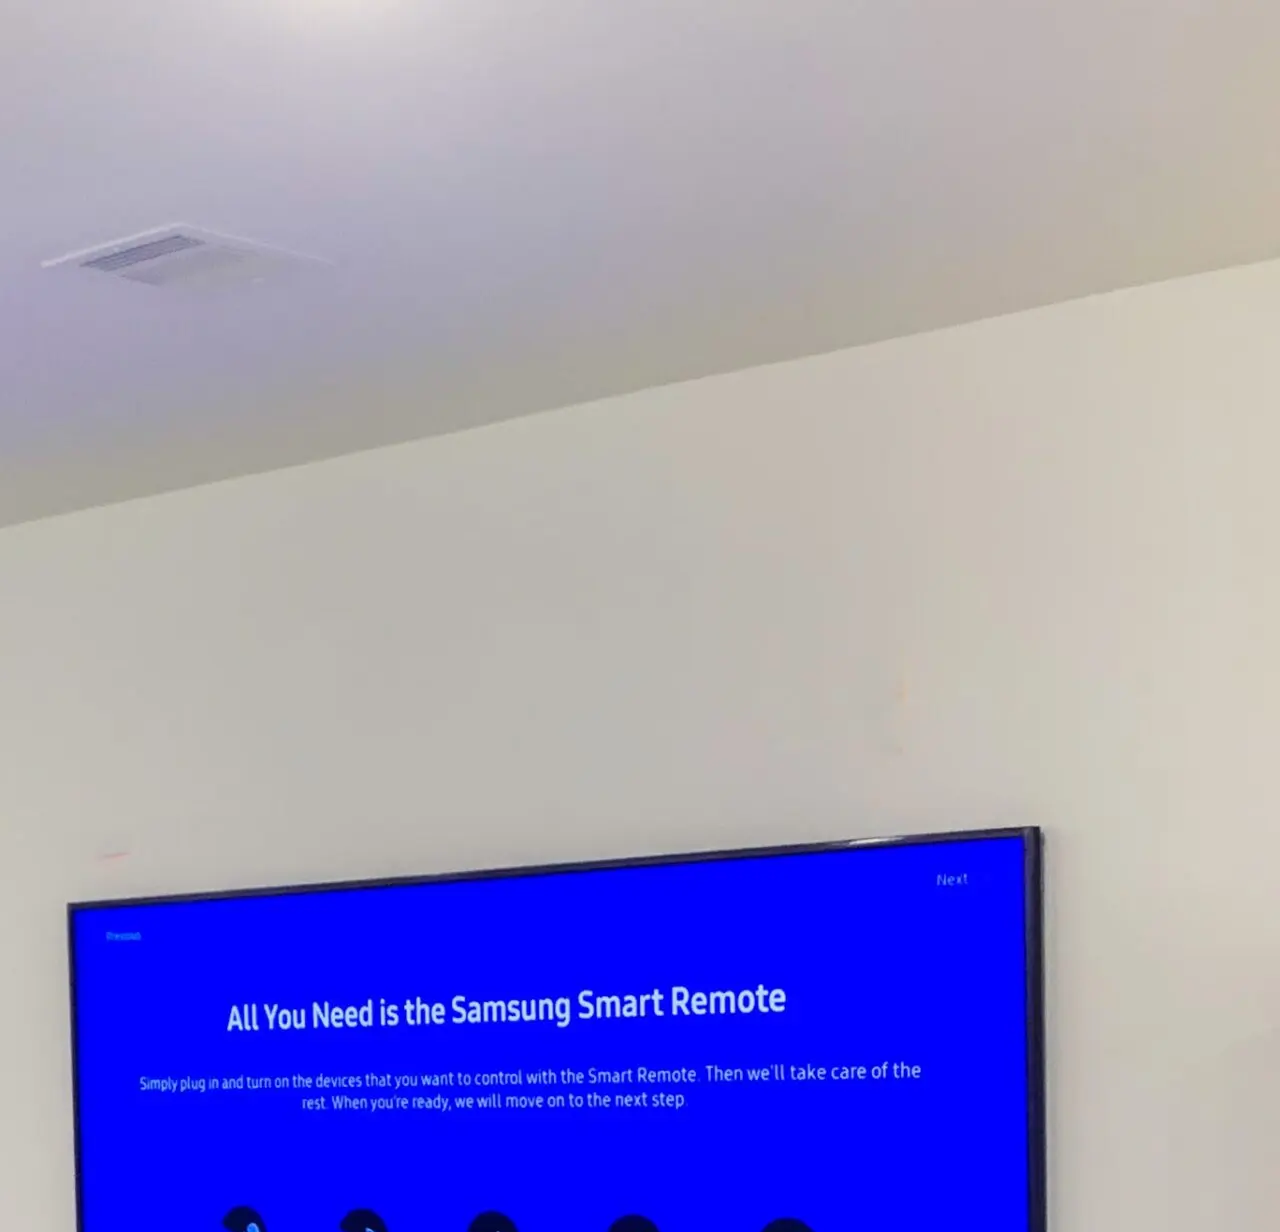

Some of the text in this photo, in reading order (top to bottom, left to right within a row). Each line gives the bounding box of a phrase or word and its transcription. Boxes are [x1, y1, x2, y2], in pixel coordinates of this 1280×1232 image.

[936, 873, 969, 885] Next
[226, 983, 787, 1032] All You Need is the Samsung Smart Remote
[139, 1076, 178, 1093] Simply
[180, 1076, 206, 1093] plug
[208, 1076, 220, 1089] in
[221, 1075, 244, 1090] and
[246, 1076, 272, 1089] turn
[274, 1077, 290, 1089] on
[292, 1074, 313, 1089] the
[315, 1073, 363, 1088] devices
[365, 1073, 392, 1087] that
[394, 1075, 418, 1090] you
[420, 1073, 454, 1086] want
[457, 1072, 472, 1086] to
[474, 1071, 523, 1086] control
[526, 1069, 557, 1085] with
[560, 1068, 585, 1085] the
[588, 1067, 633, 1084] Smart
[705, 1065, 744, 1082] Then
[746, 1064, 785, 1081] we'll
[790, 1063, 827, 1081] take
[830, 1066, 867, 1080] care
[871, 1061, 889, 1080] of
[892, 1061, 922, 1079] the
[331, 1095, 368, 1110] When
[370, 1095, 409, 1112] you're
[412, 1094, 452, 1112] ready,
[454, 1096, 474, 1109] we
[476, 1093, 502, 1108] will
[505, 1096, 544, 1109] move
[547, 1095, 565, 1108] on
[568, 1093, 584, 1108] to
[586, 1092, 612, 1108] the
[615, 1092, 648, 1107] next
